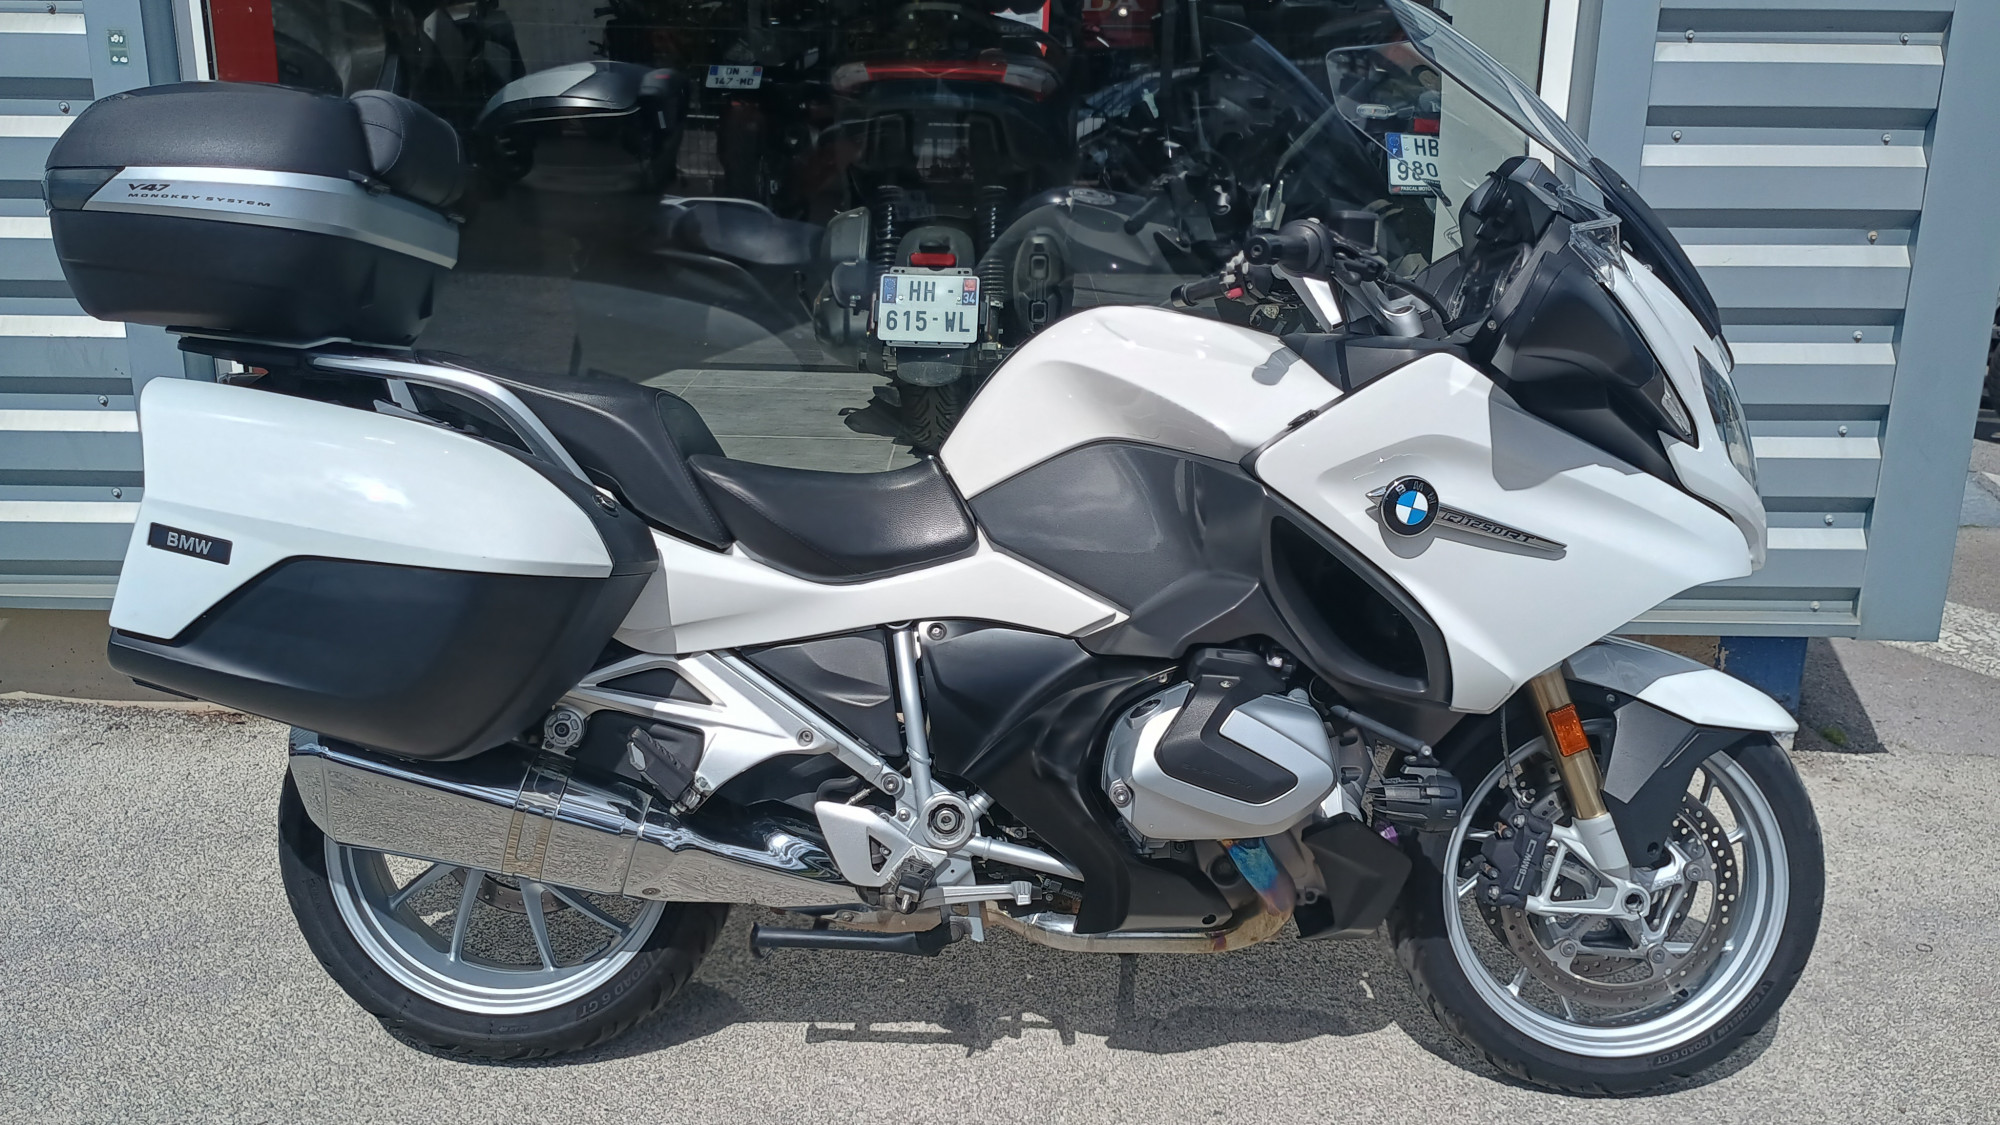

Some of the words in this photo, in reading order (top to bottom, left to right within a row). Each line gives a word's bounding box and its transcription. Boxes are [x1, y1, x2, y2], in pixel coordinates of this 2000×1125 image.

[1397, 160, 1439, 181] 980
[128, 183, 171, 192] V47
[205, 196, 271, 207] SYSTEM
[1395, 480, 1437, 505] BMW
[166, 531, 213, 555] BMW
[1519, 852, 1533, 876] BMW
[614, 959, 650, 995] ROAD
[580, 1000, 599, 1017] GT
[1717, 995, 1760, 1037] MICHELIN
[1681, 1038, 1709, 1056] ROAD
[1657, 1055, 1670, 1064] GT
